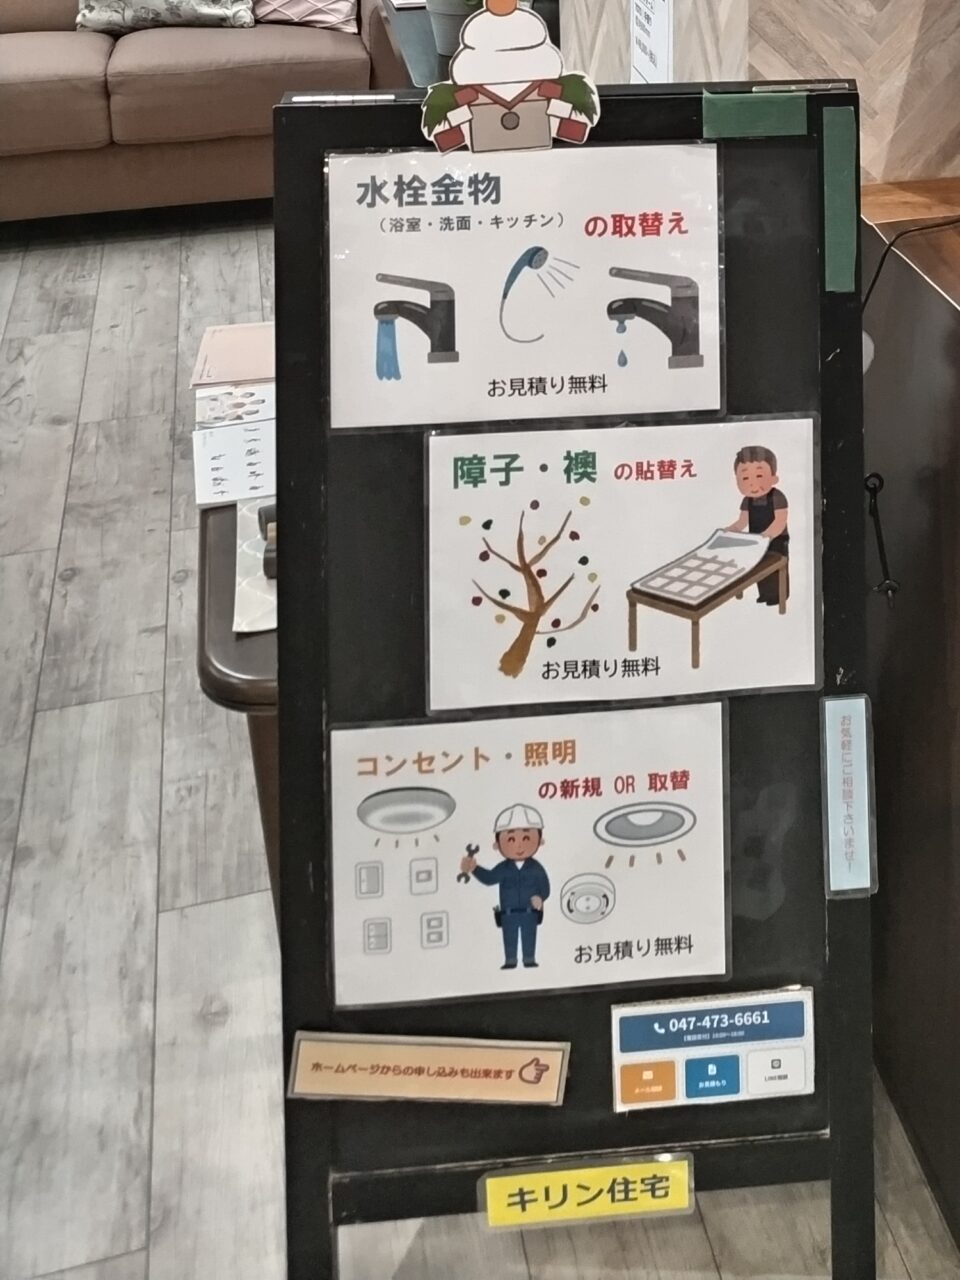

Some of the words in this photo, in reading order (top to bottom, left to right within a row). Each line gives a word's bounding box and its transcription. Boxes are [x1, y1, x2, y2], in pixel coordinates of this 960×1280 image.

[356, 171, 501, 208] 水栓金物
[584, 210, 690, 238] の取替え
[486, 373, 609, 398] お見積り無料
[452, 449, 599, 489] 障子・襖
[613, 458, 698, 482] の貼替え
[540, 656, 662, 681] お見積り無料
[356, 738, 578, 778] コンセント・照明
[537, 777, 603, 801] の新規
[613, 774, 636, 796] OR
[647, 769, 691, 793] 取替
[573, 934, 694, 964] お見積り無料
[669, 1010, 770, 1033] 047-473-6661
[505, 1174, 671, 1214] キリン住宅
